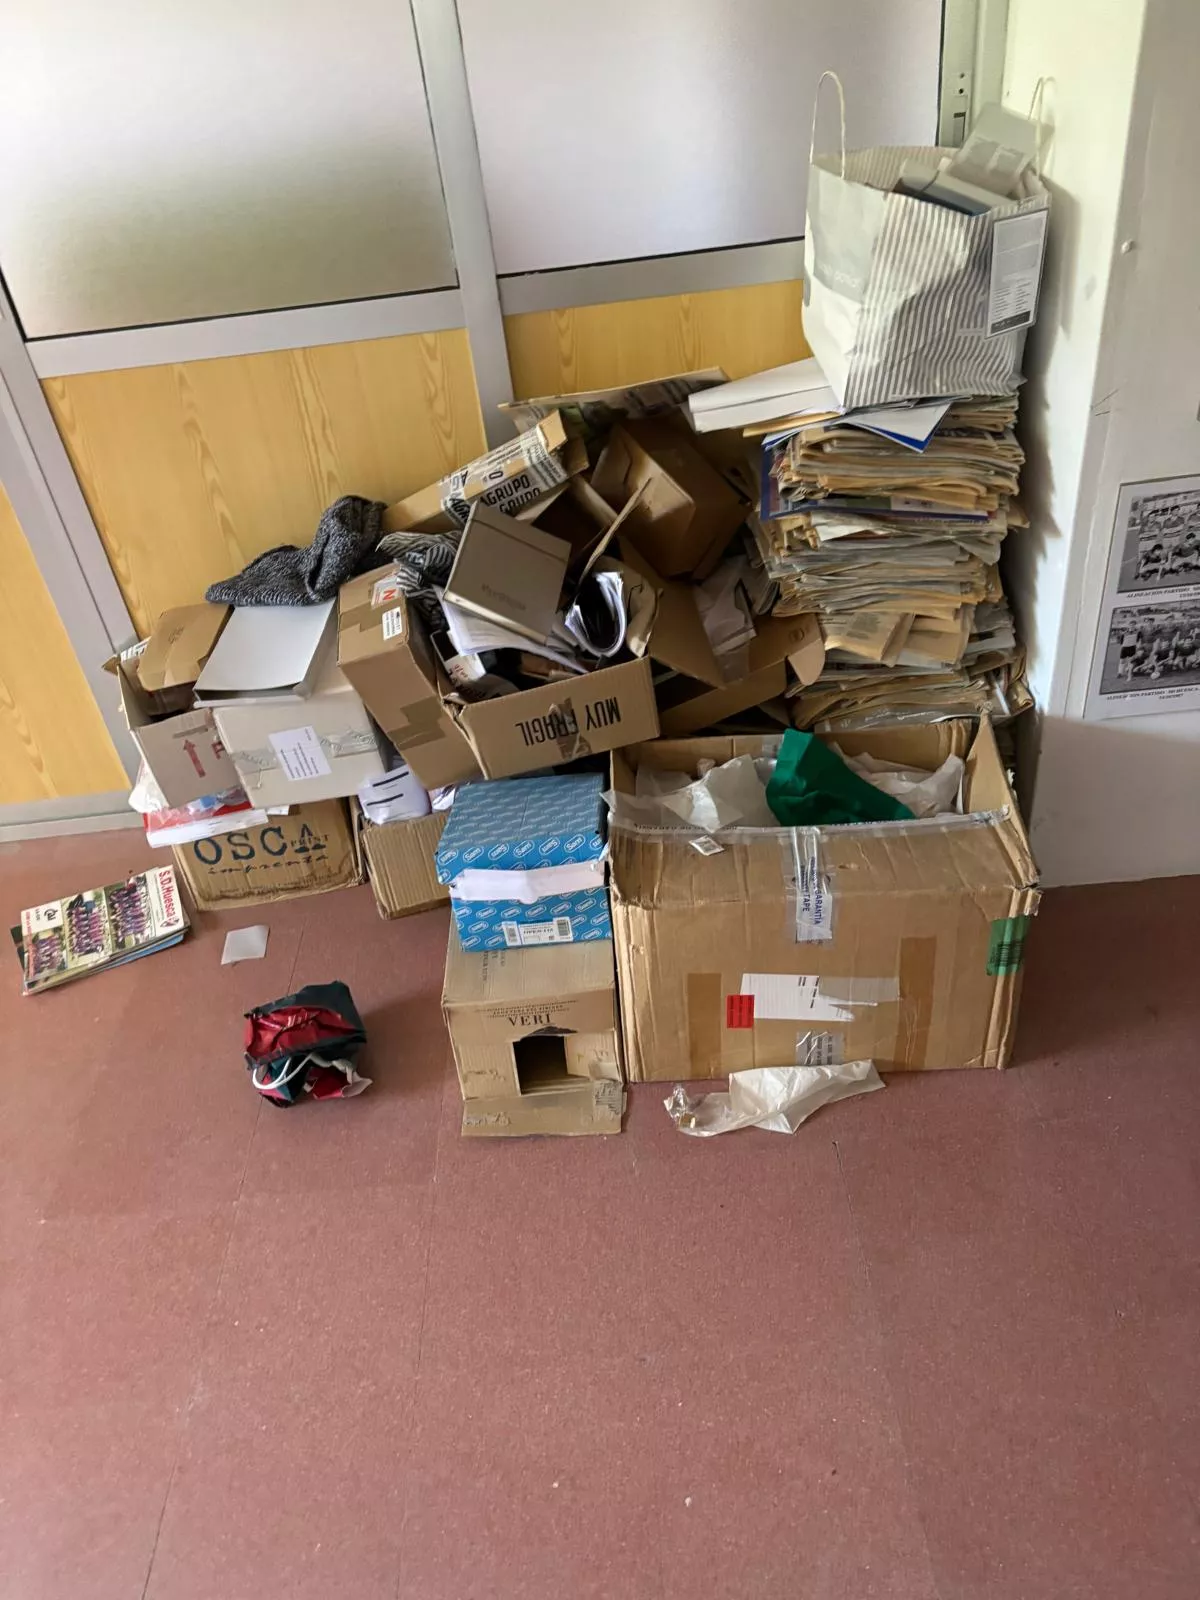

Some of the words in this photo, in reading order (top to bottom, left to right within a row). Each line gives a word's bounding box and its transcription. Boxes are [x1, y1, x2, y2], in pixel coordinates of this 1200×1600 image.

[585, 696, 621, 731] MUY
[193, 823, 326, 865] OSCA
[515, 842, 533, 855] Sam
[465, 848, 482, 860] Sam
[508, 1013, 551, 1026] VERI
